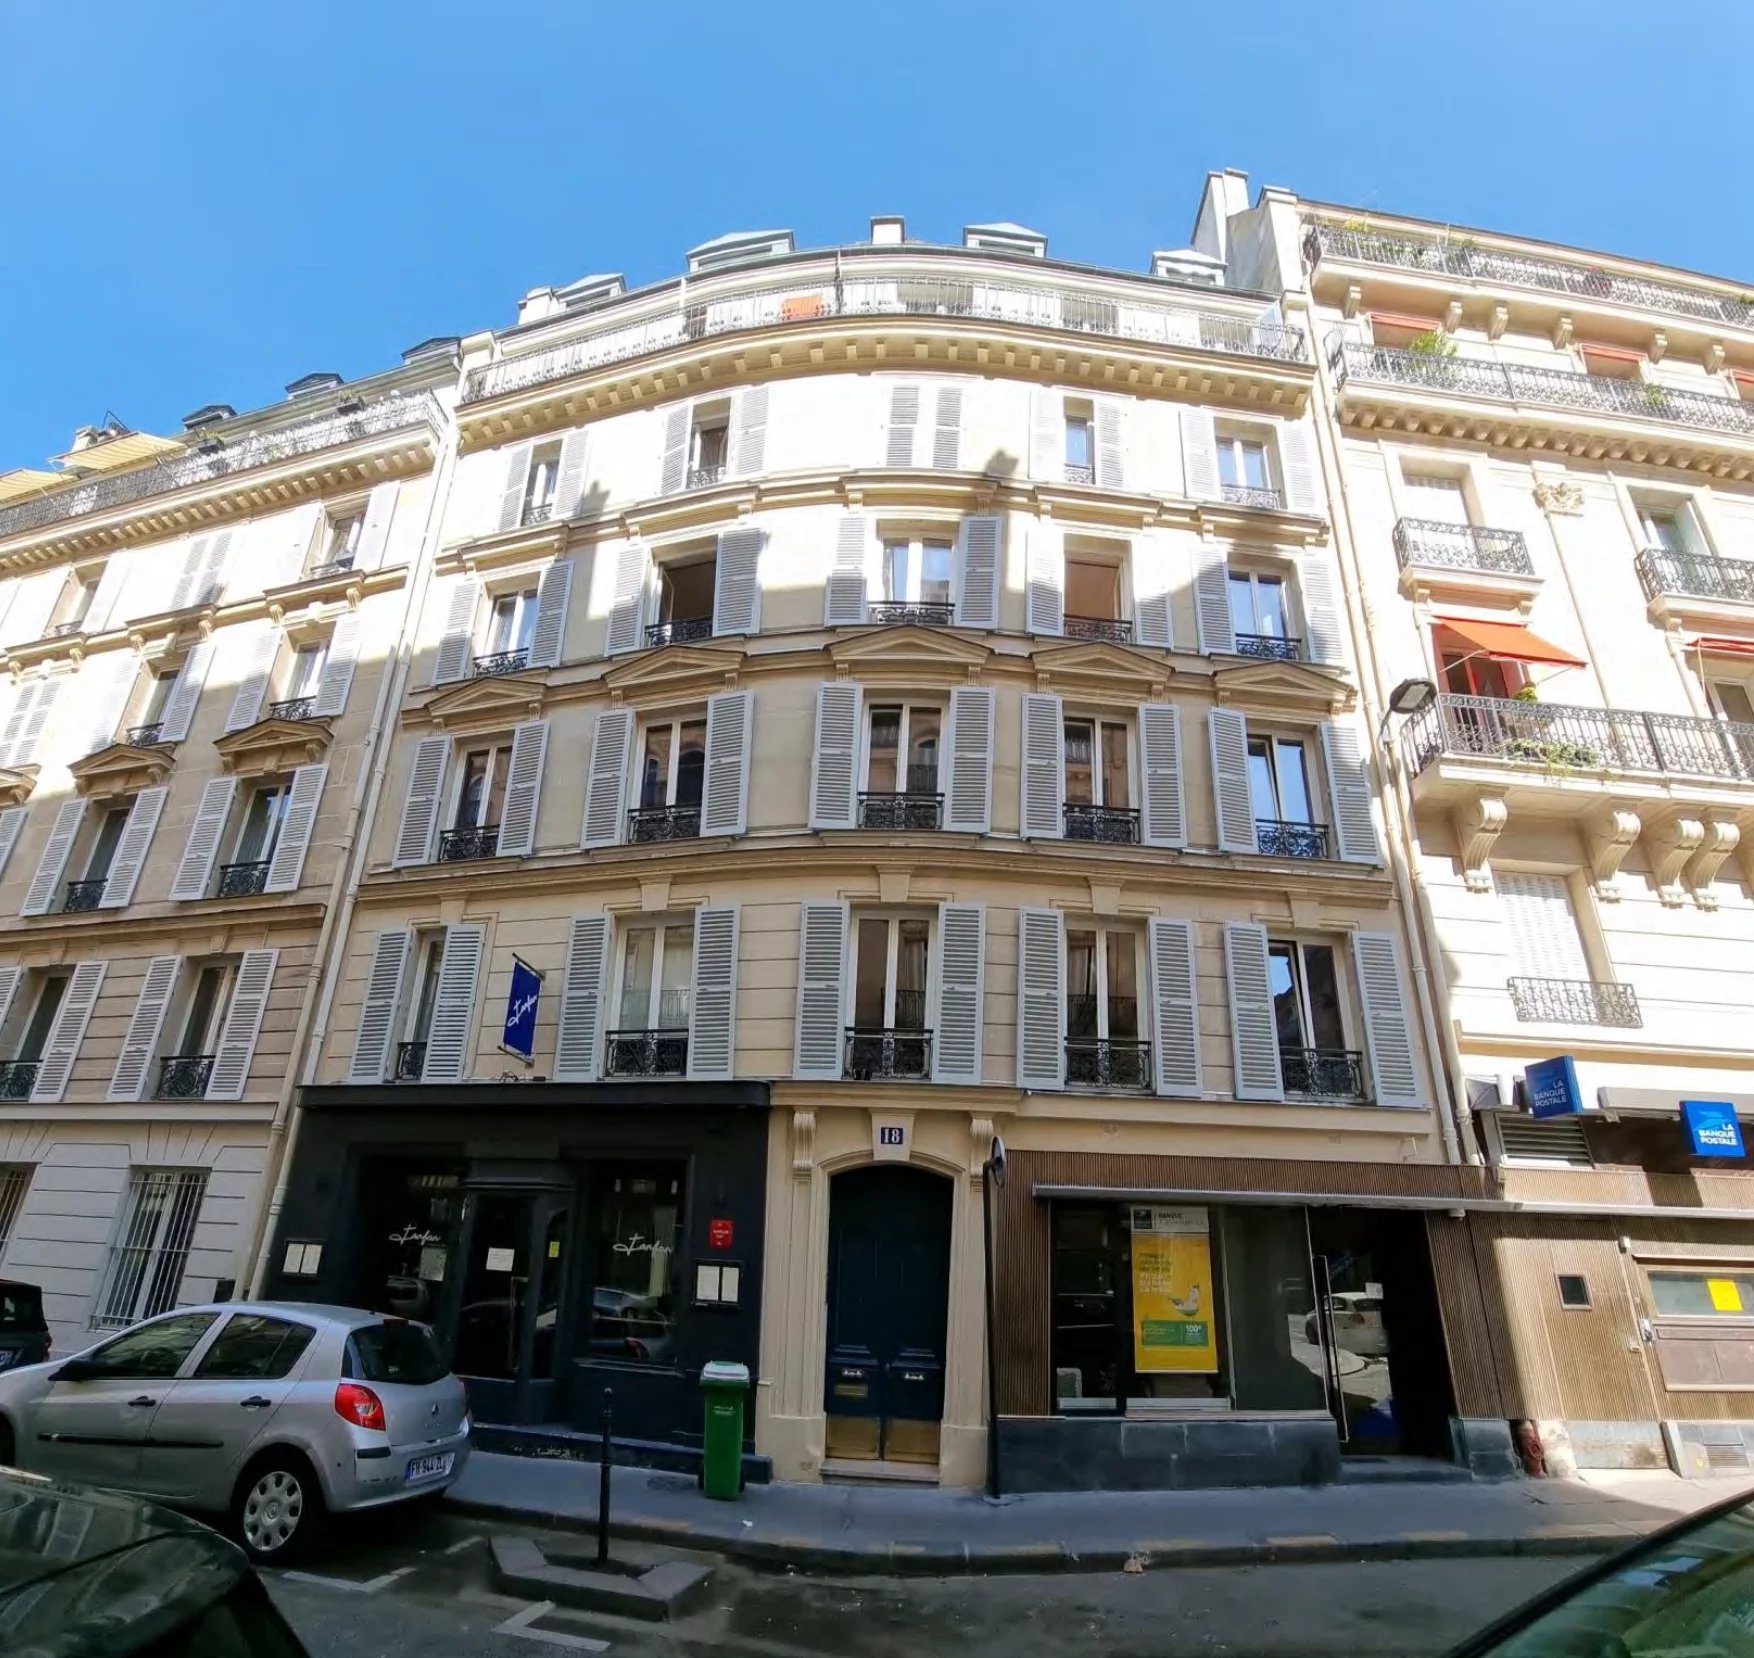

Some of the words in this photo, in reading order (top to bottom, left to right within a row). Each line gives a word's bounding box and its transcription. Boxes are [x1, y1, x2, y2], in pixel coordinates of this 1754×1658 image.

[1552, 1079, 1564, 1089] LA
[1534, 1087, 1566, 1101] BANQUE
[1535, 1094, 1567, 1107] POSTALE
[1721, 1123, 1735, 1131] LA
[884, 1128, 900, 1144] 18
[1698, 1129, 1736, 1139] BANQUE
[1700, 1136, 1738, 1146] POSTALE
